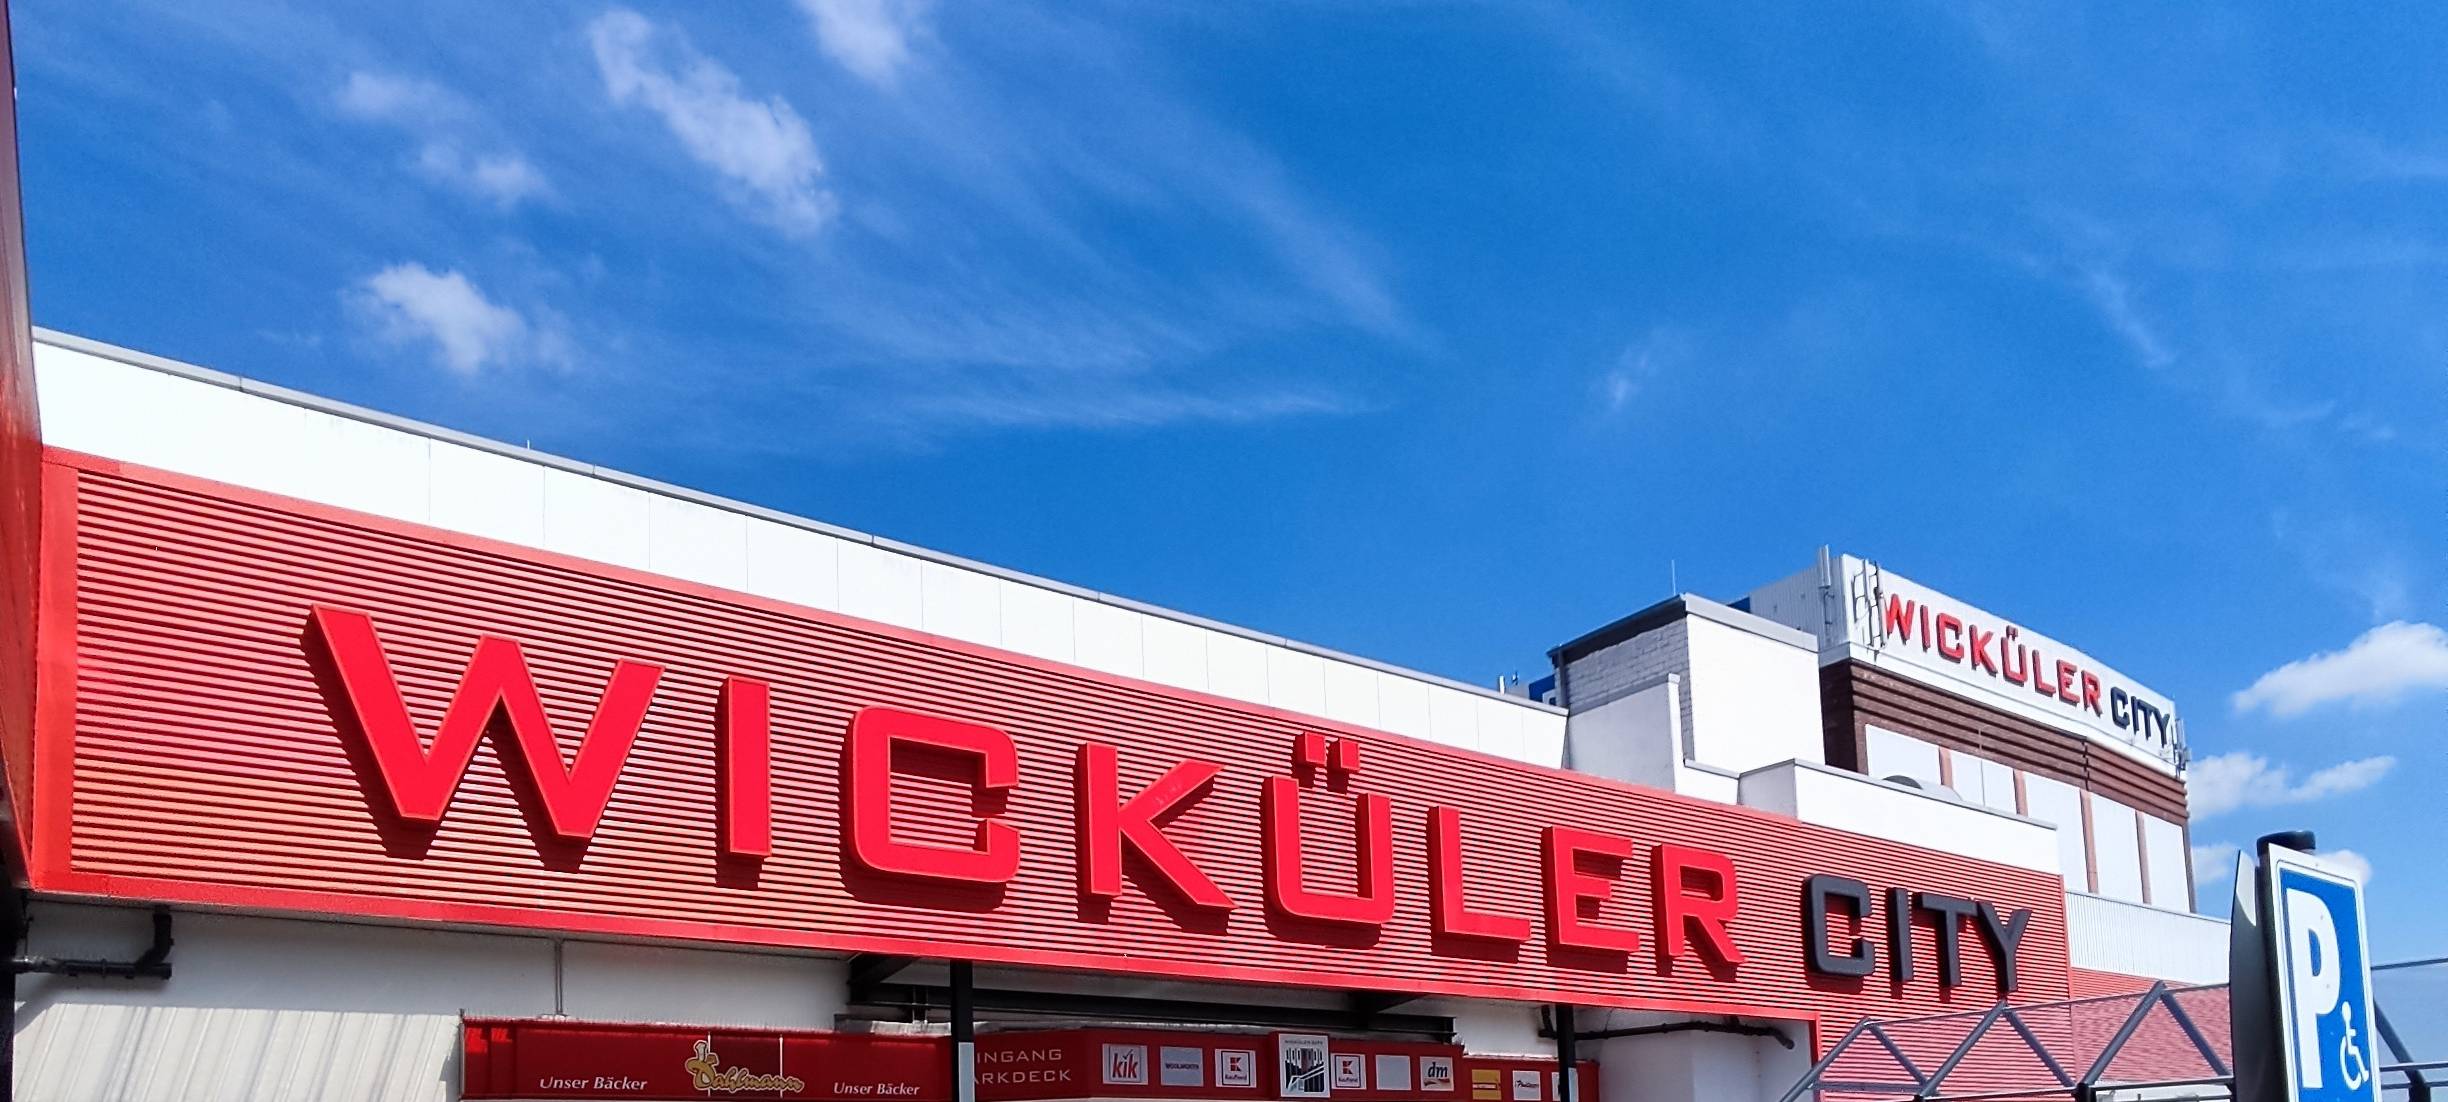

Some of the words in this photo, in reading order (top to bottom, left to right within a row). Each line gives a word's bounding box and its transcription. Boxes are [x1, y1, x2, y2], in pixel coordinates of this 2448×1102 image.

[1883, 593, 2103, 717] WICKÜLER
[2110, 686, 2170, 748] CITY
[309, 604, 1744, 969] WICKÜLER
[1802, 873, 2031, 993] CITY
[2286, 887, 2341, 1089] P
[976, 1049, 1063, 1064] INGANG
[974, 1068, 1072, 1085] RKDECK
[1427, 1061, 1449, 1079] dm
[540, 1076, 591, 1091] Unser
[593, 1076, 649, 1092] Bäcker
[833, 1082, 875, 1096] Unser
[876, 1083, 921, 1097] Bäcker
